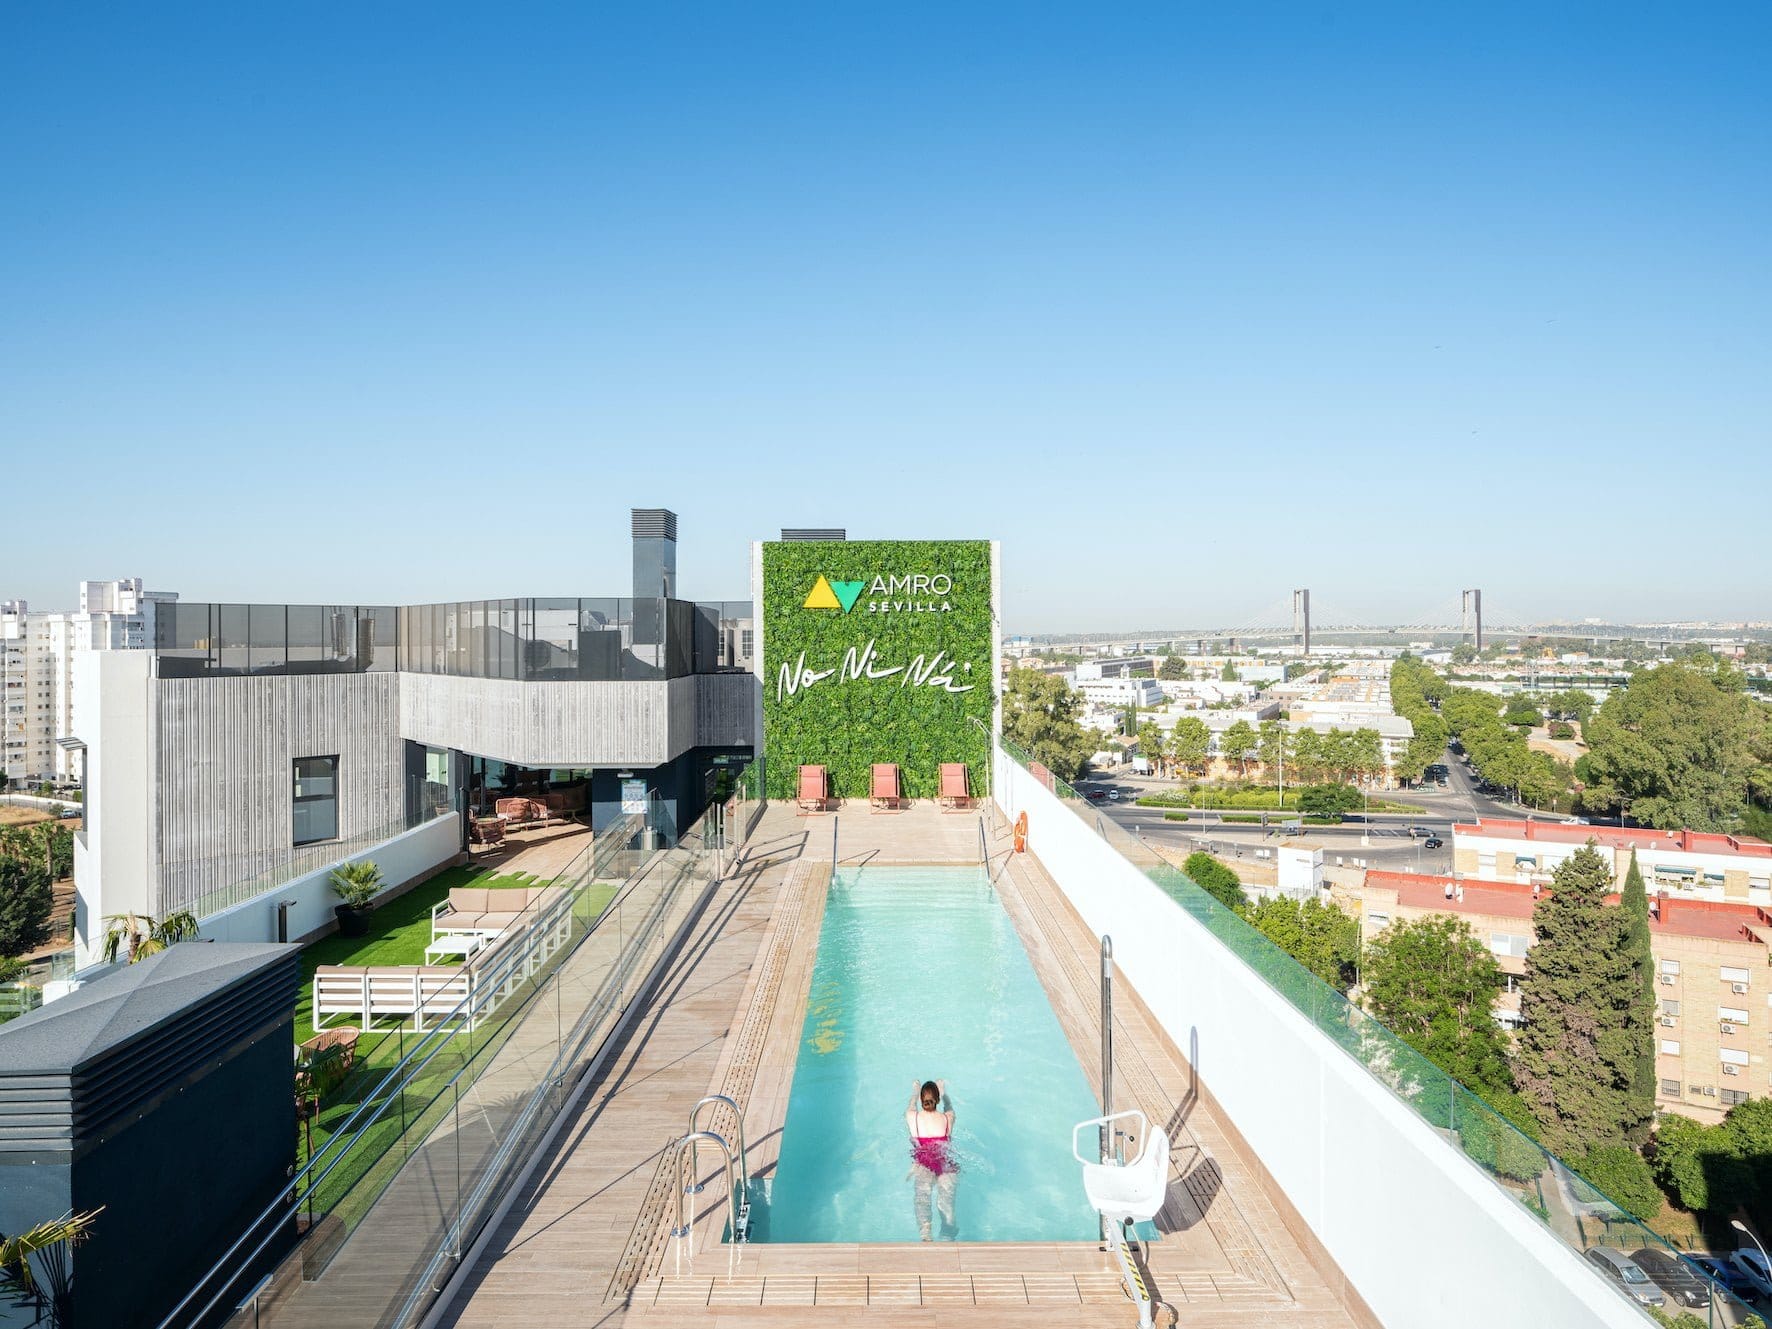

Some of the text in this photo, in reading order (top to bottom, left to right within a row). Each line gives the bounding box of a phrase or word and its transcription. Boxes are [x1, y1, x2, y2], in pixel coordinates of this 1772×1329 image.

[869, 574, 952, 595] AMRO
[869, 601, 952, 612] SEVILLA
[777, 650, 836, 703] No
[840, 637, 904, 684] Ni
